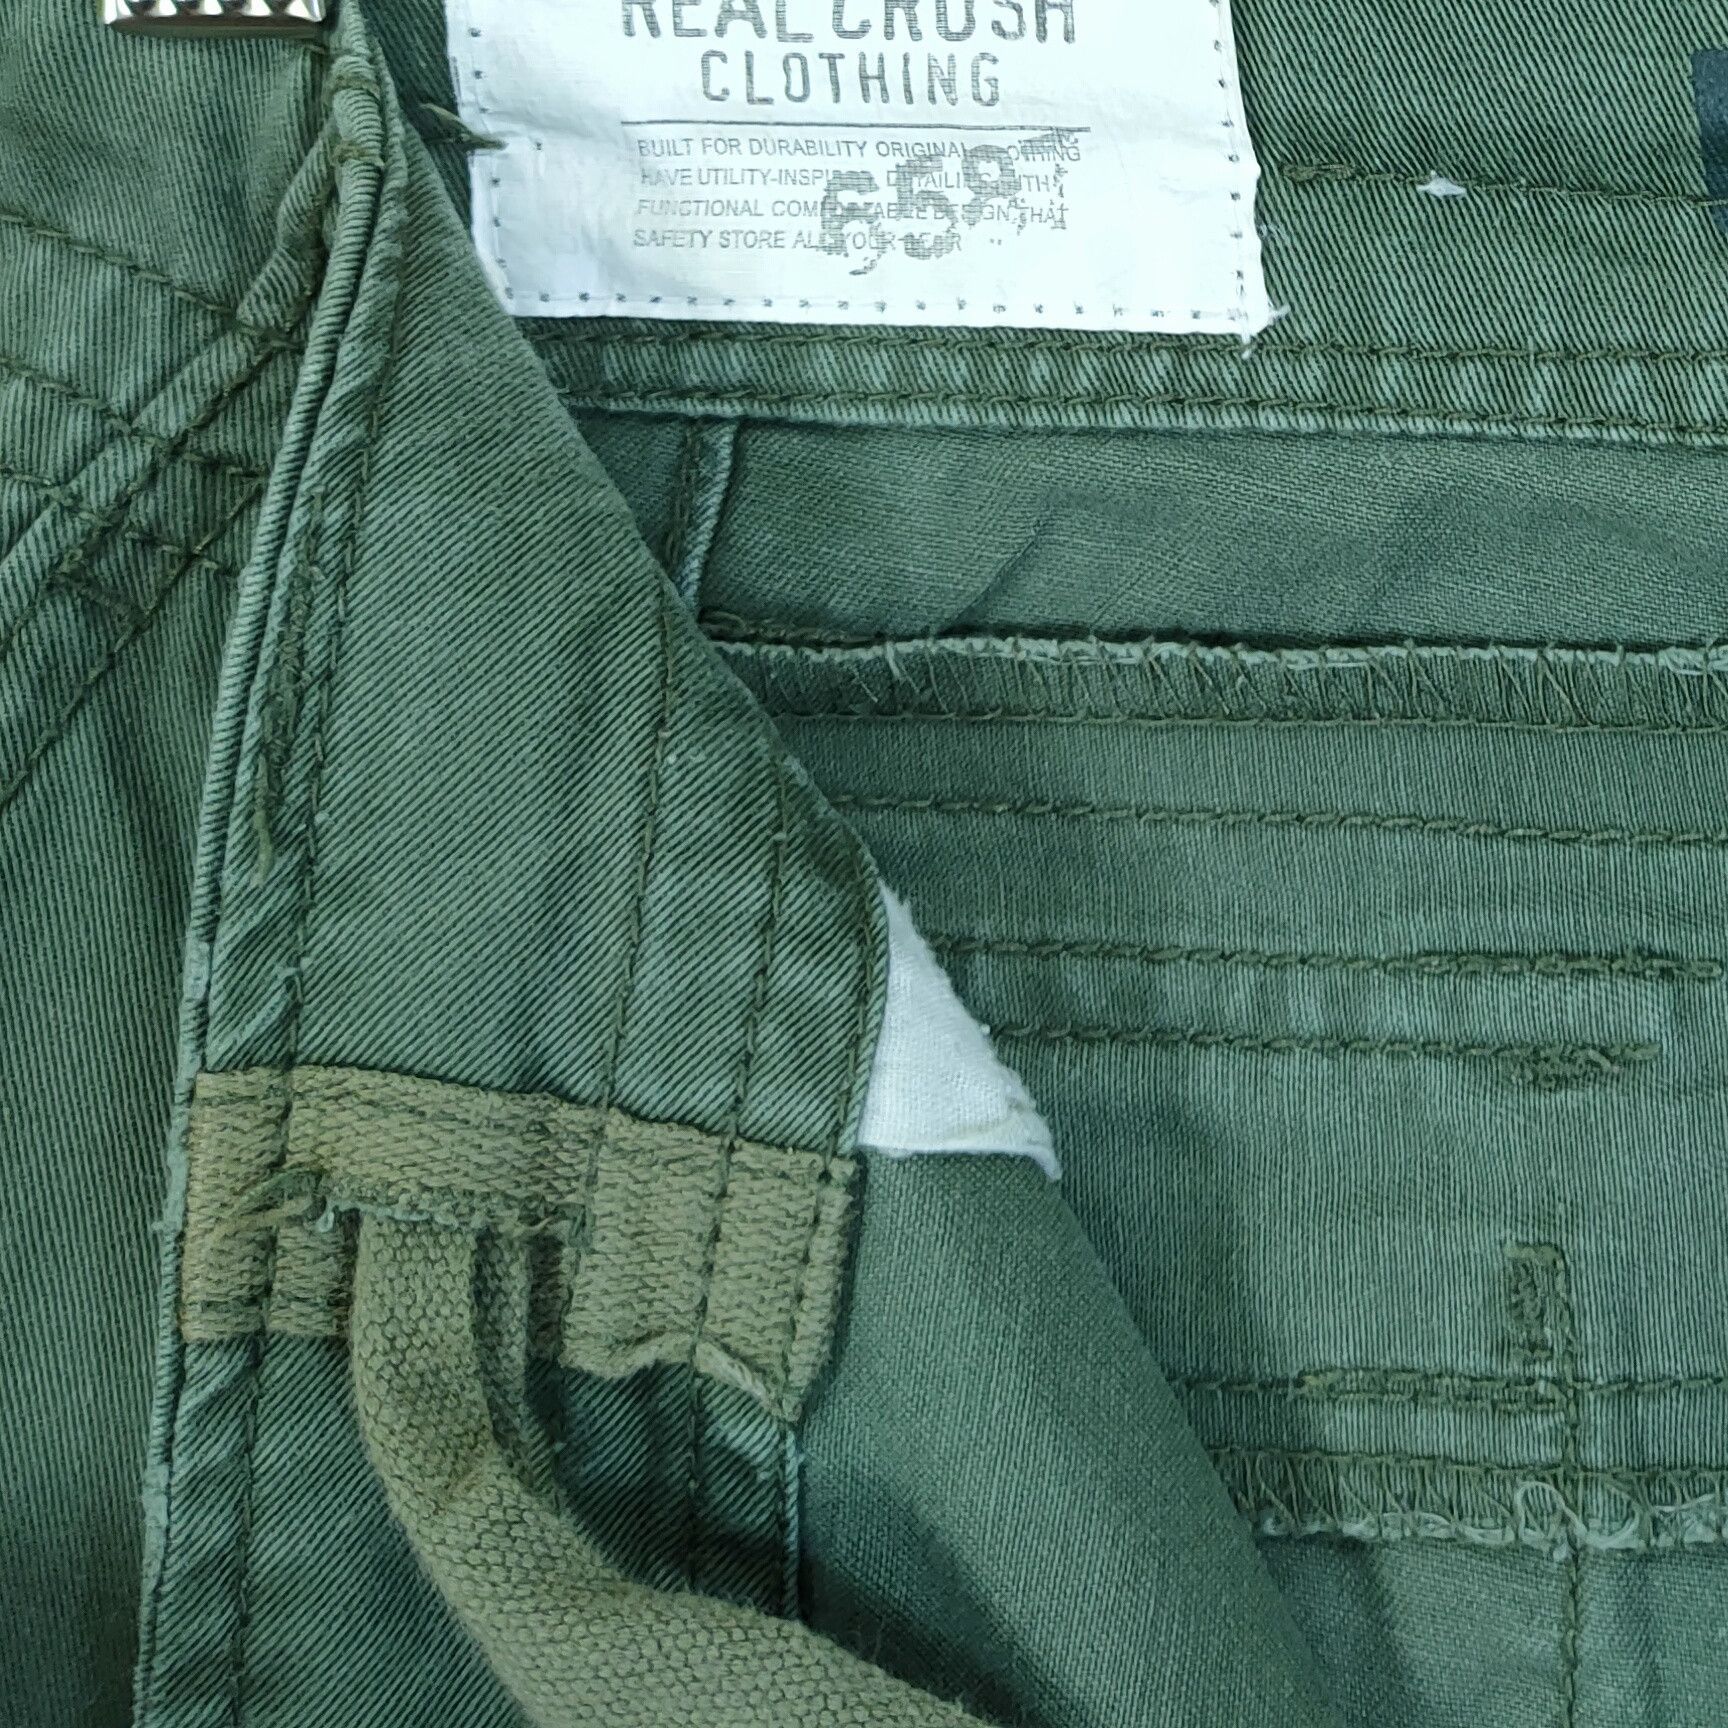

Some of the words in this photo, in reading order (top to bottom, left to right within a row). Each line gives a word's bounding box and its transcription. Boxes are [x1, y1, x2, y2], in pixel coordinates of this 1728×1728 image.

[700, 49, 1000, 107] CLOTHING
[637, 138, 694, 158] BUILT
[702, 137, 743, 157] FOR
[749, 138, 868, 159] DURABILITY
[976, 144, 1081, 162] OTHING
[641, 168, 694, 186] HAVE
[698, 168, 880, 189] UTILITY-INSPI
[1002, 174, 1051, 193] ITH
[634, 199, 764, 218] FUNCTIONAL
[772, 200, 928, 221] COMOTABLE
[933, 203, 1010, 222] DESGN
[633, 229, 713, 249] SAFETY
[719, 230, 785, 250] STORE
